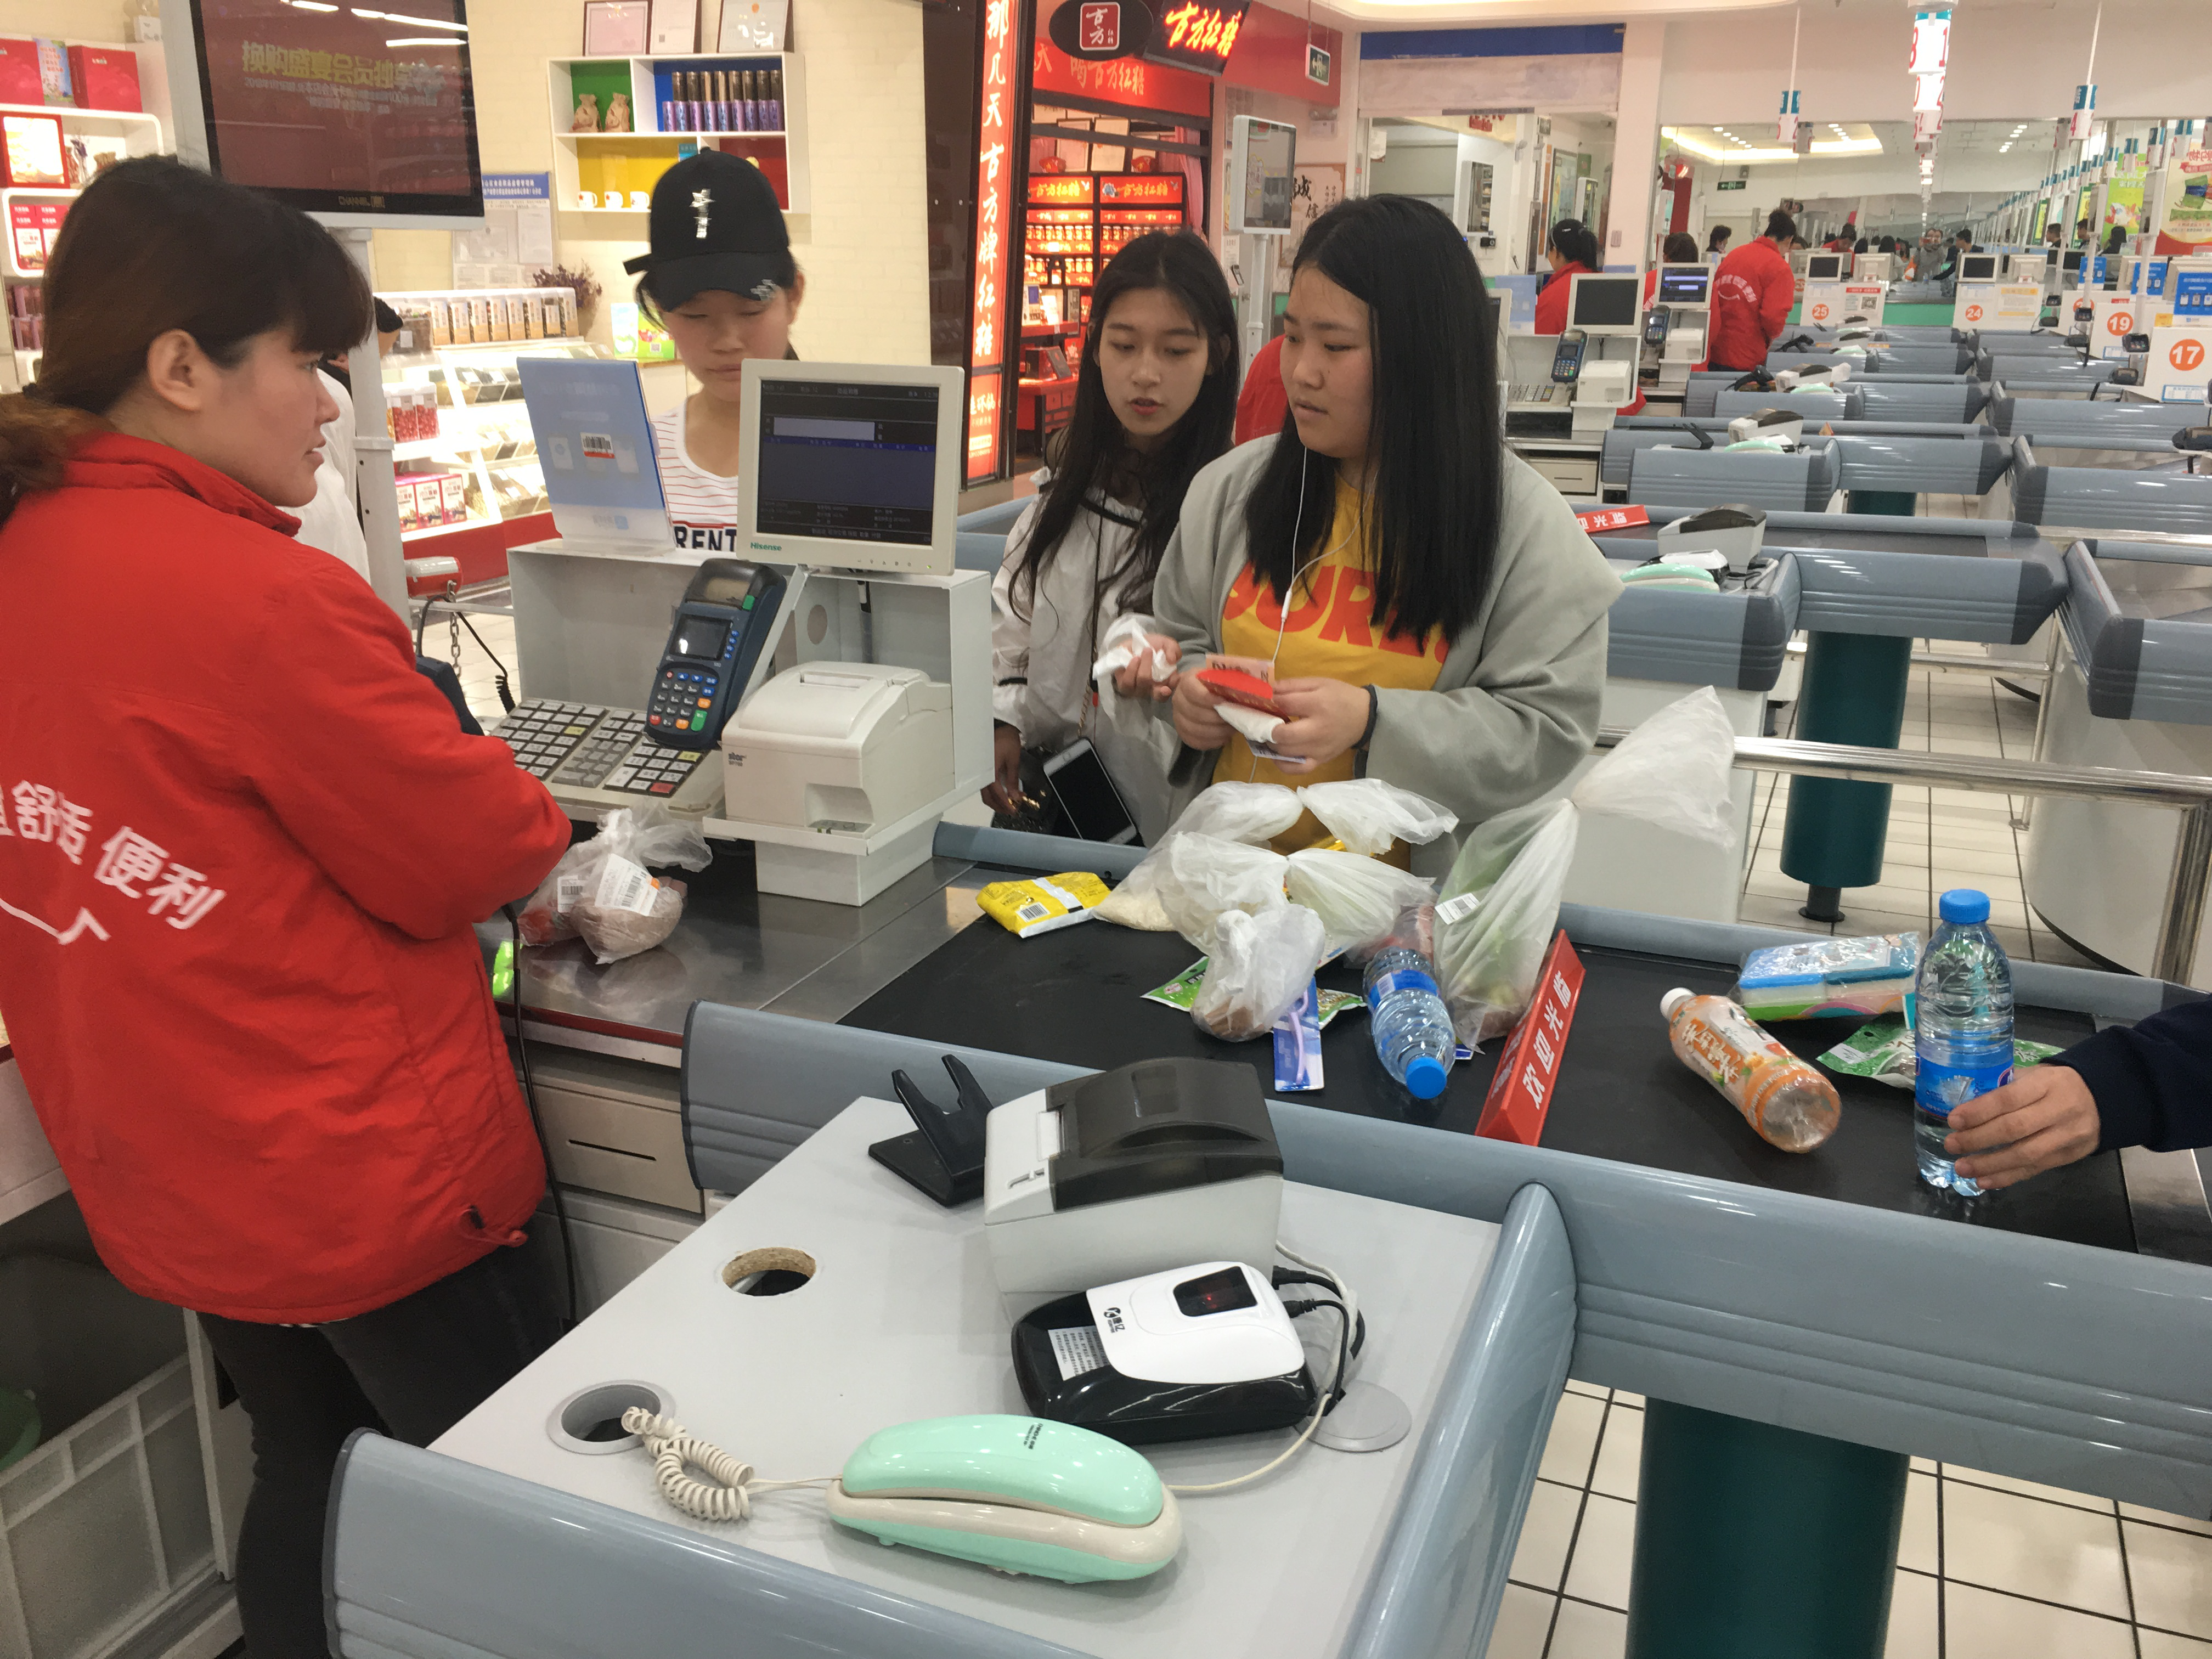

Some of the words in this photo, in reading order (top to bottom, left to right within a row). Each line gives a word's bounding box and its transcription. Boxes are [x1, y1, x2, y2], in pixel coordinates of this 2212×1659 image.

[1086, 8, 1108, 45] 古方
[1165, 1, 1242, 57] 古方红糖
[1813, 307, 1829, 317] 25
[1967, 308, 1982, 318] 24
[2109, 316, 2130, 332] 19
[2172, 345, 2200, 365] 17
[750, 542, 782, 551] Hisense
[94, 825, 227, 929] 便利
[1522, 970, 1572, 1111] 欢迎光临
